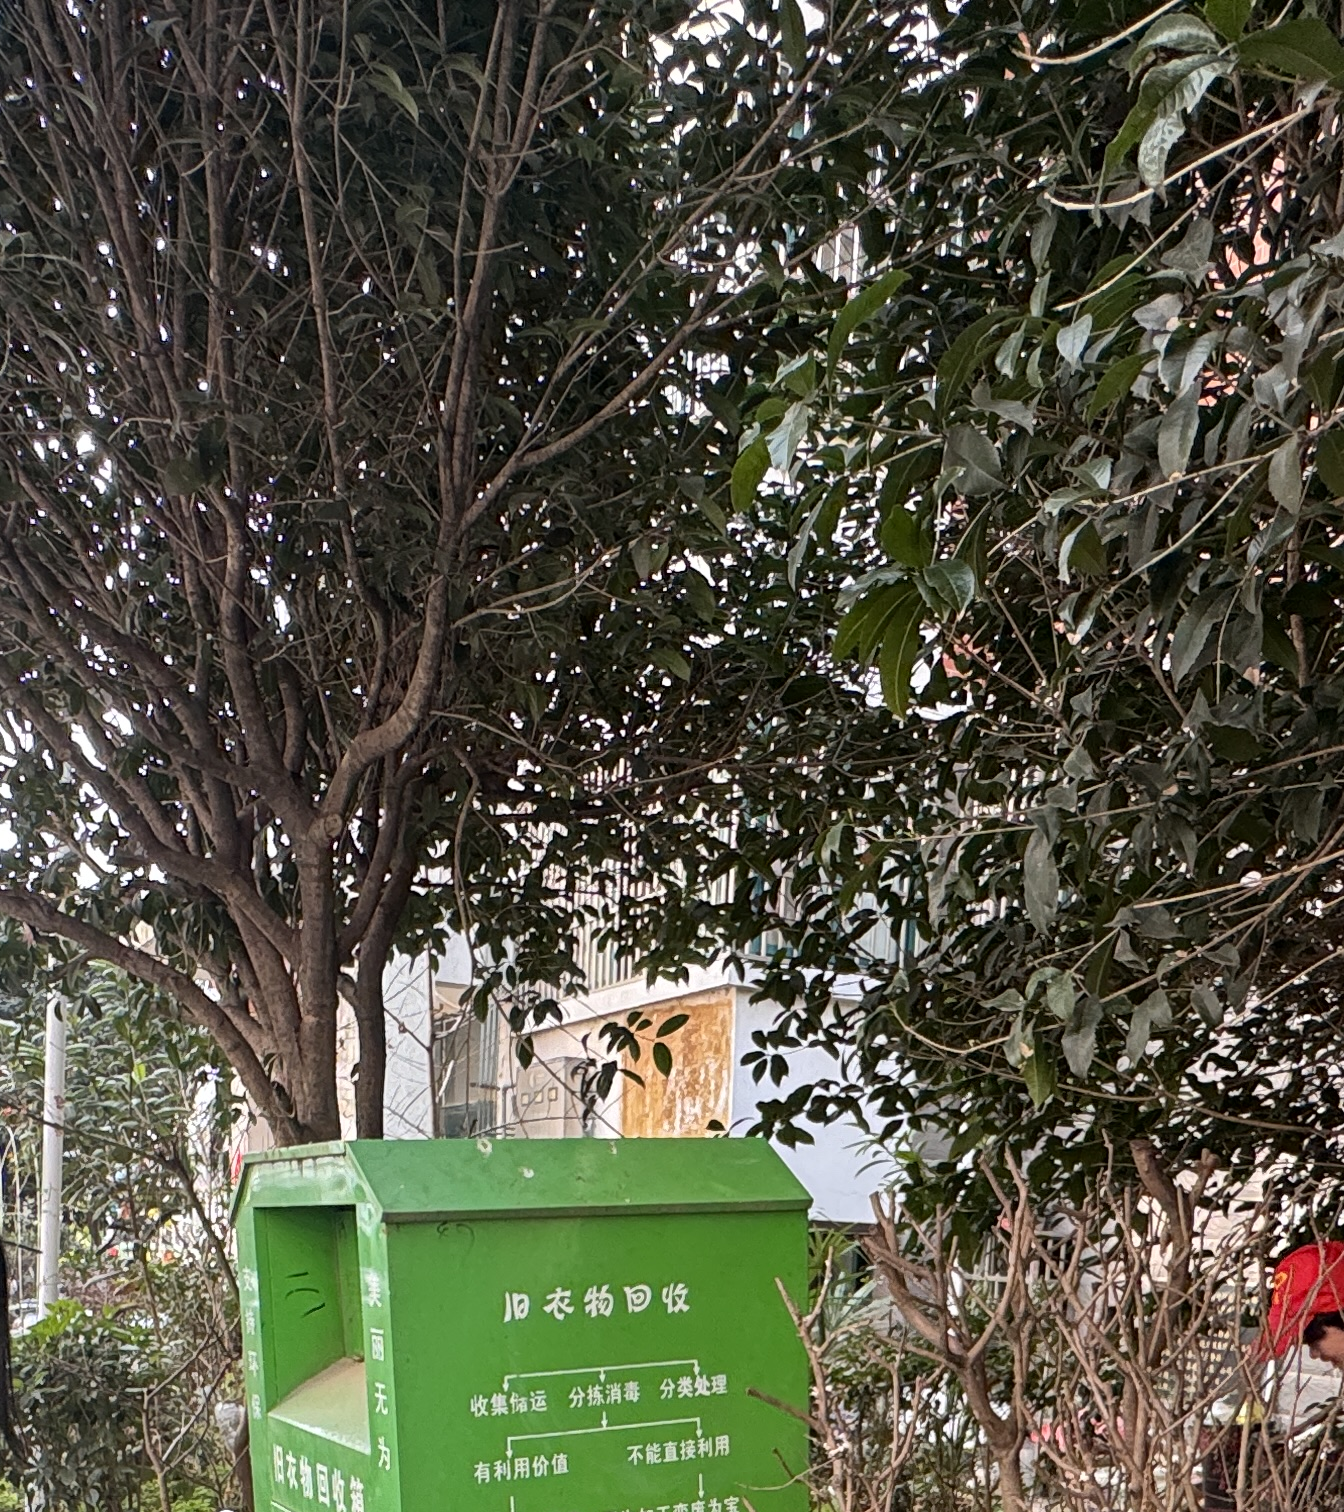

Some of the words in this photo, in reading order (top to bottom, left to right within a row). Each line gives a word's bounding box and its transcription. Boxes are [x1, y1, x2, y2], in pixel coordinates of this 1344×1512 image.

[504, 1283, 690, 1323] 旧衣物回收
[568, 1381, 641, 1409] 分拣消毒
[659, 1374, 728, 1400] 分类处理
[470, 1390, 548, 1418] 收集储运
[627, 1434, 731, 1466] 不能直接利用
[474, 1453, 570, 1484] 有利用价值
